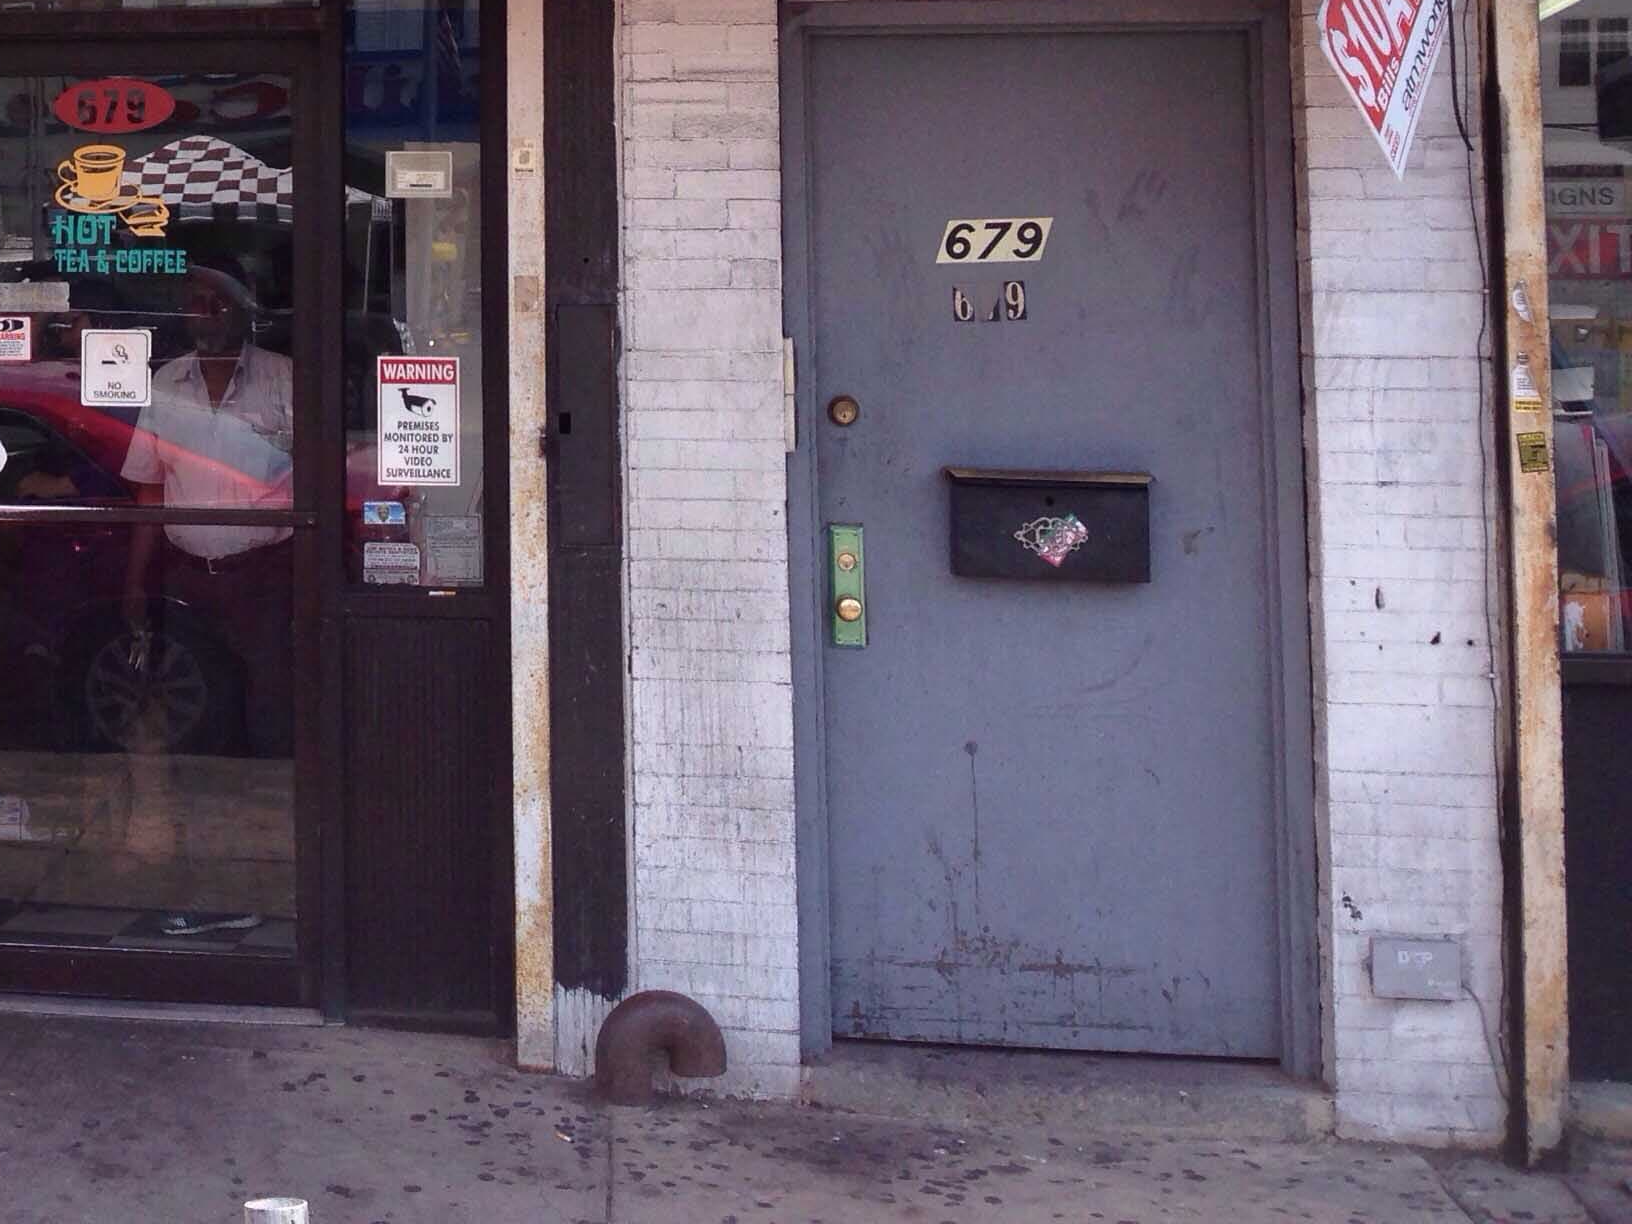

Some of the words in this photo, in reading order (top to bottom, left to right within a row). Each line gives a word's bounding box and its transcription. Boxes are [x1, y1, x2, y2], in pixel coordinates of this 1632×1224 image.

[1376, 57, 1400, 112] Bills
[76, 88, 147, 125] 679
[53, 214, 117, 245] HOT
[944, 221, 1044, 260] 679
[54, 248, 90, 274] TEA
[96, 249, 110, 274] &
[116, 249, 188, 274] COFFEE
[953, 281, 1027, 322] 69
[382, 363, 455, 381] WARNING
[107, 382, 122, 390] NO
[93, 390, 136, 399] SMOKING
[397, 421, 439, 432] PREMISES
[384, 433, 439, 443] MONITORED
[442, 433, 454, 443] BY
[398, 445, 409, 454] 24
[411, 445, 439, 455] HOUR
[404, 456, 433, 467] VIDEO
[386, 467, 452, 479] SURVEILLANCE
